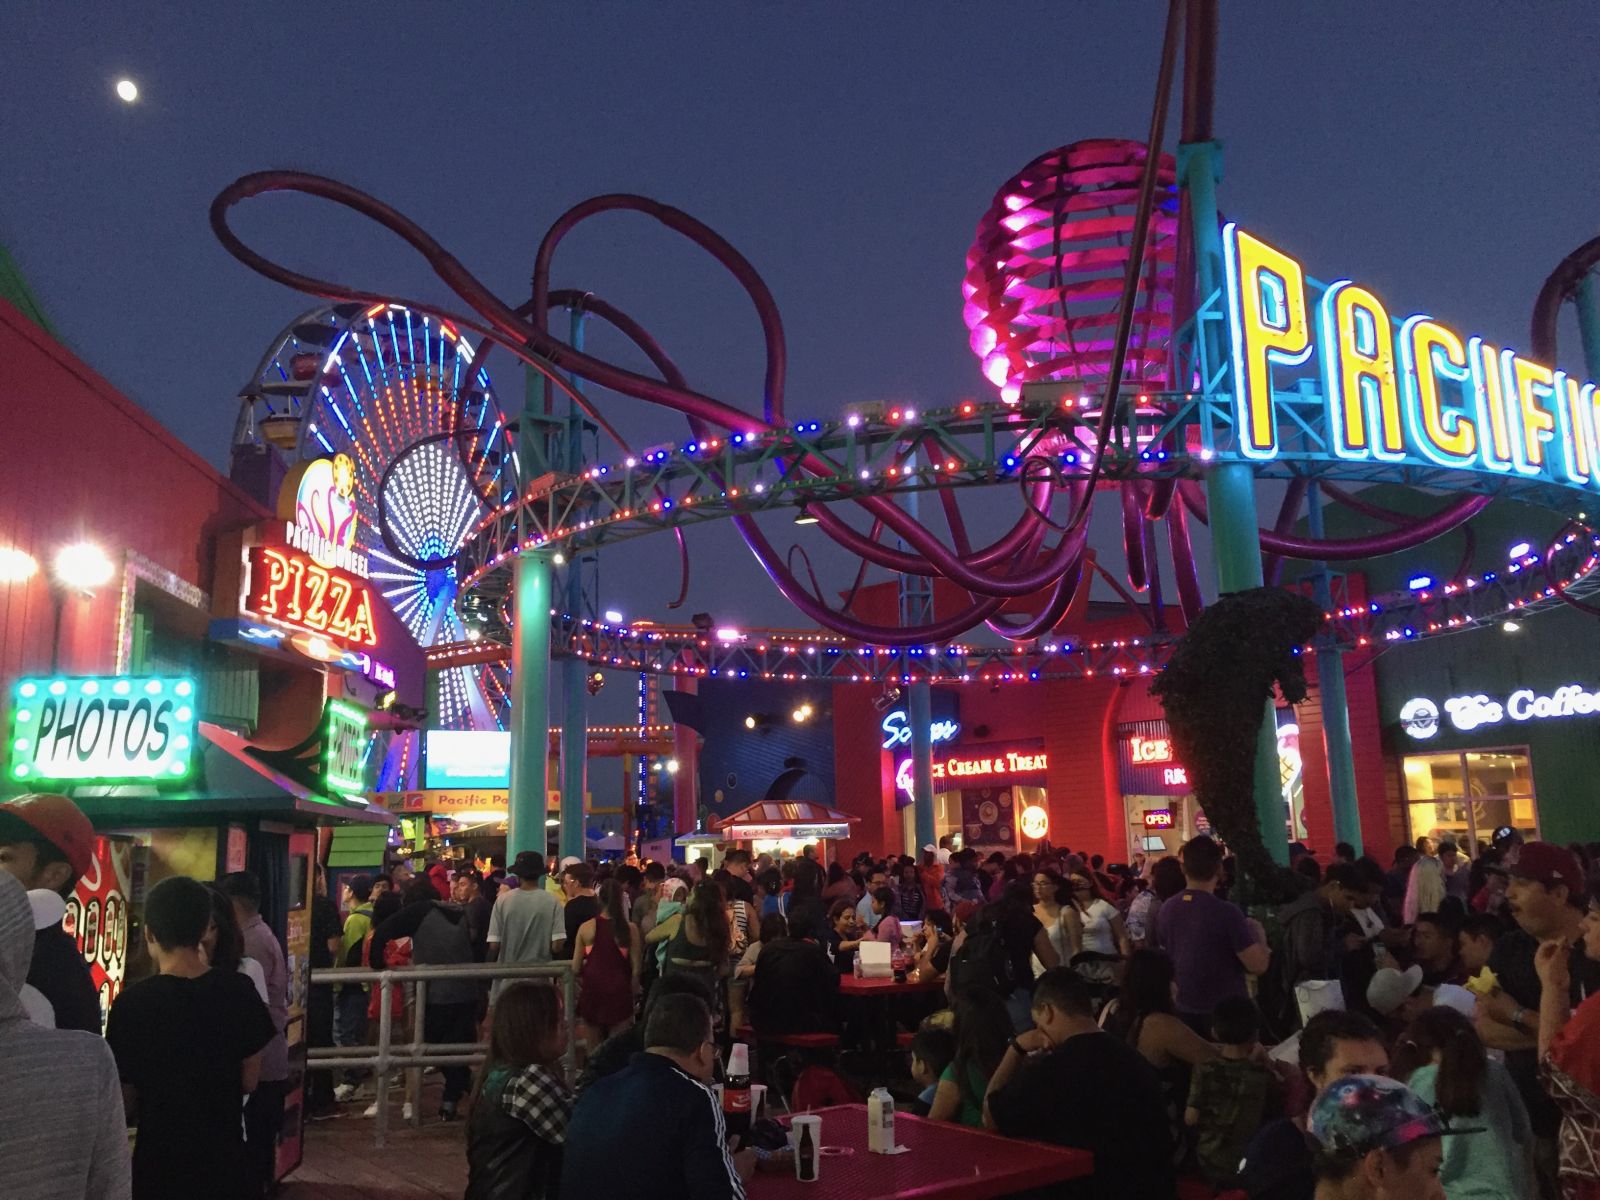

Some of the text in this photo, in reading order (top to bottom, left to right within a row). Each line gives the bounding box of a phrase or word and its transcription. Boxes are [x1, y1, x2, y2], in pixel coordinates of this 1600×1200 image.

[336, 544, 369, 580] WHEEL
[260, 549, 377, 646] PIZZA
[1444, 694, 1503, 731] The
[33, 697, 173, 762] PHOTOS
[1130, 736, 1172, 762] ICE
[932, 763, 945, 778] CE
[947, 758, 992, 776] CREAM
[994, 758, 1005, 773] &
[438, 794, 509, 807] Pacific Pa
[1145, 814, 1172, 825] OPEN
